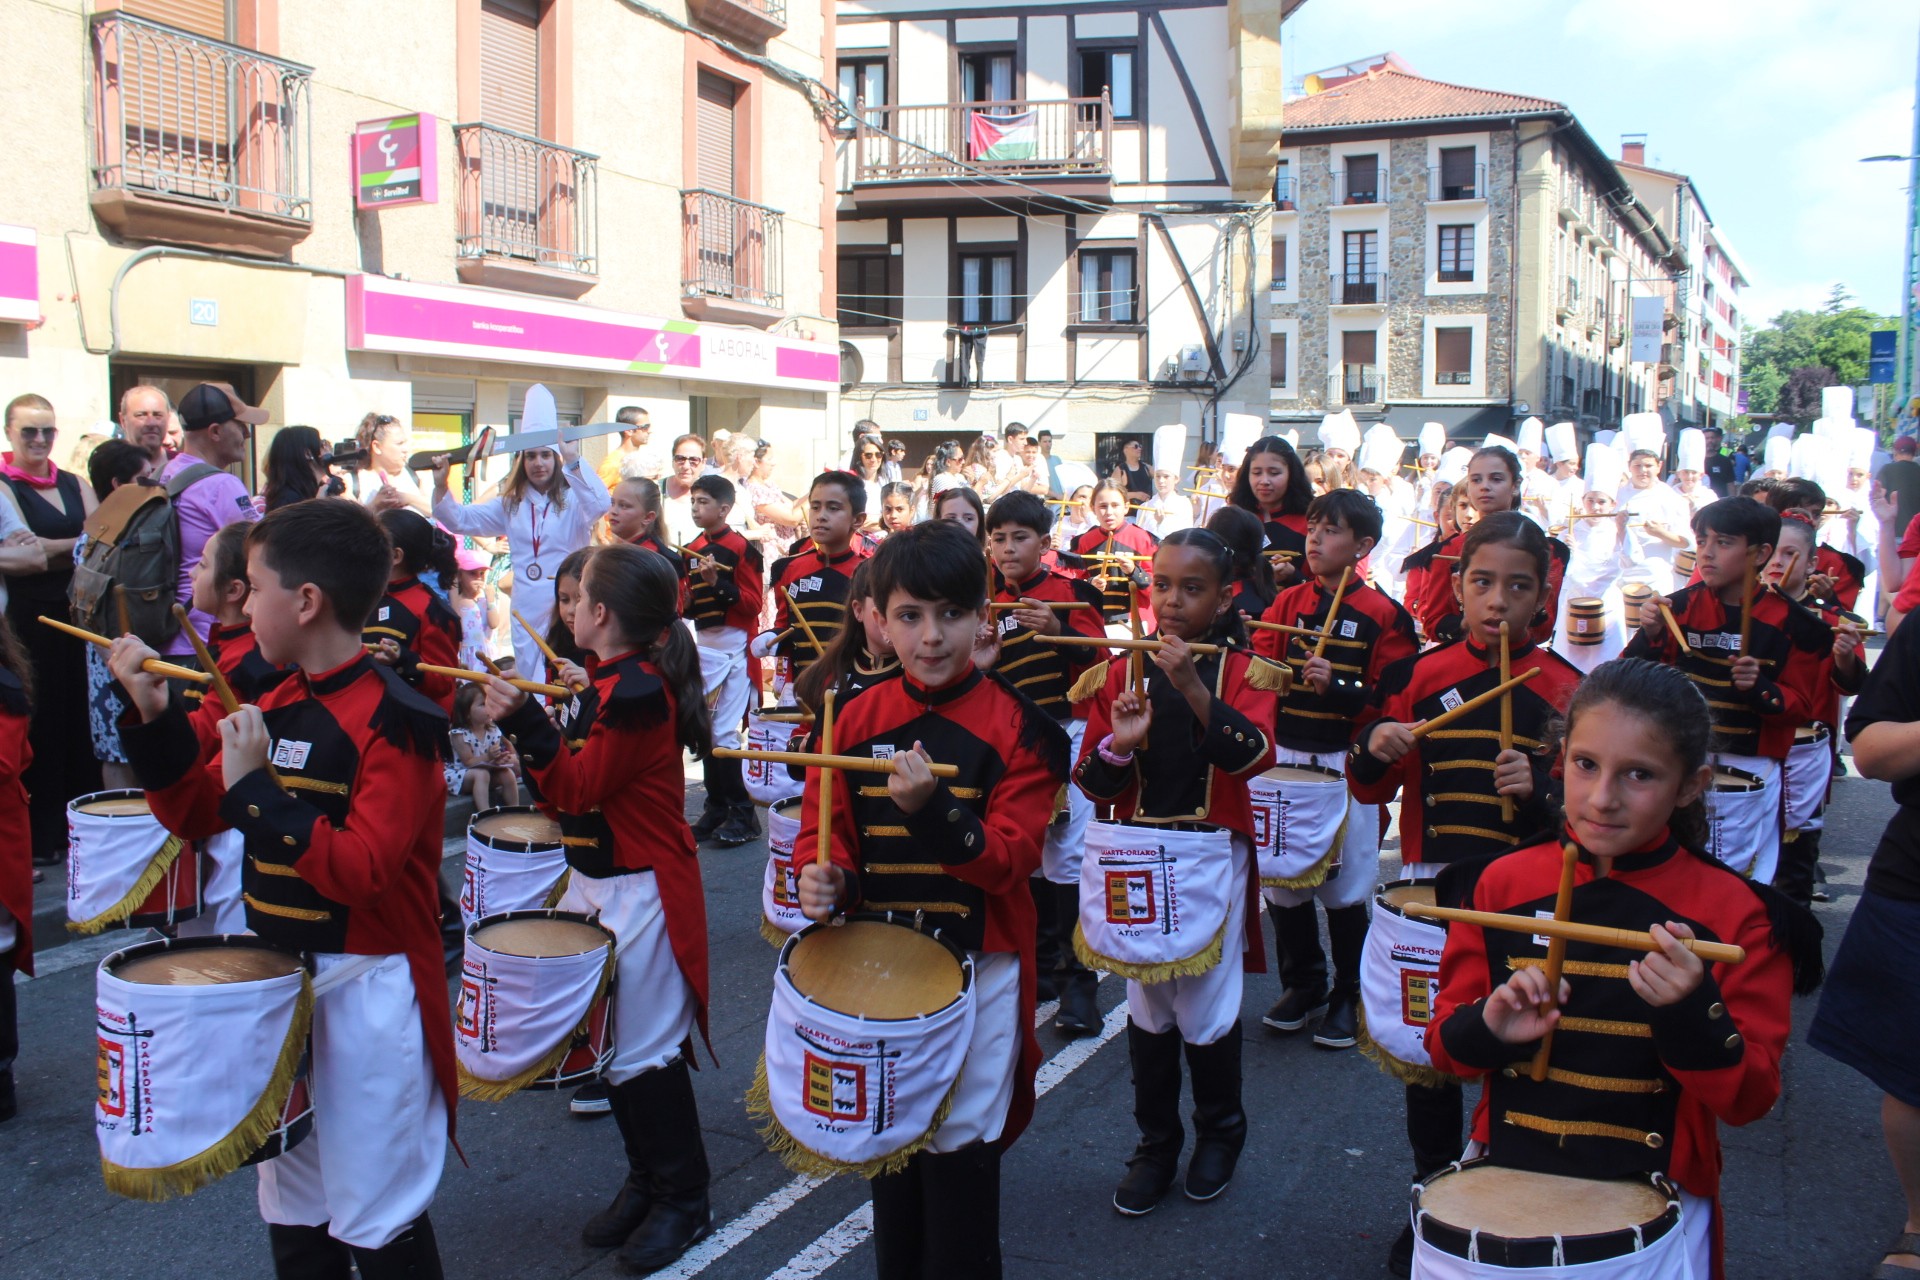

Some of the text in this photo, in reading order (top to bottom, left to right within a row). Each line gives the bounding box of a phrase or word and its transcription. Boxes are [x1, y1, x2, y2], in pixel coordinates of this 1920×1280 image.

[193, 302, 215, 321] 20
[710, 337, 768, 360] LABORAL
[1167, 865, 1180, 933] DANBORRADA
[1393, 942, 1444, 957] LASARTE-ORI
[488, 984, 498, 1053] DANBORRADA
[795, 1021, 874, 1051] LASARTE-ORIAKO
[141, 1041, 154, 1133] DANBORRADA
[886, 1061, 897, 1131] DANBORRADA
